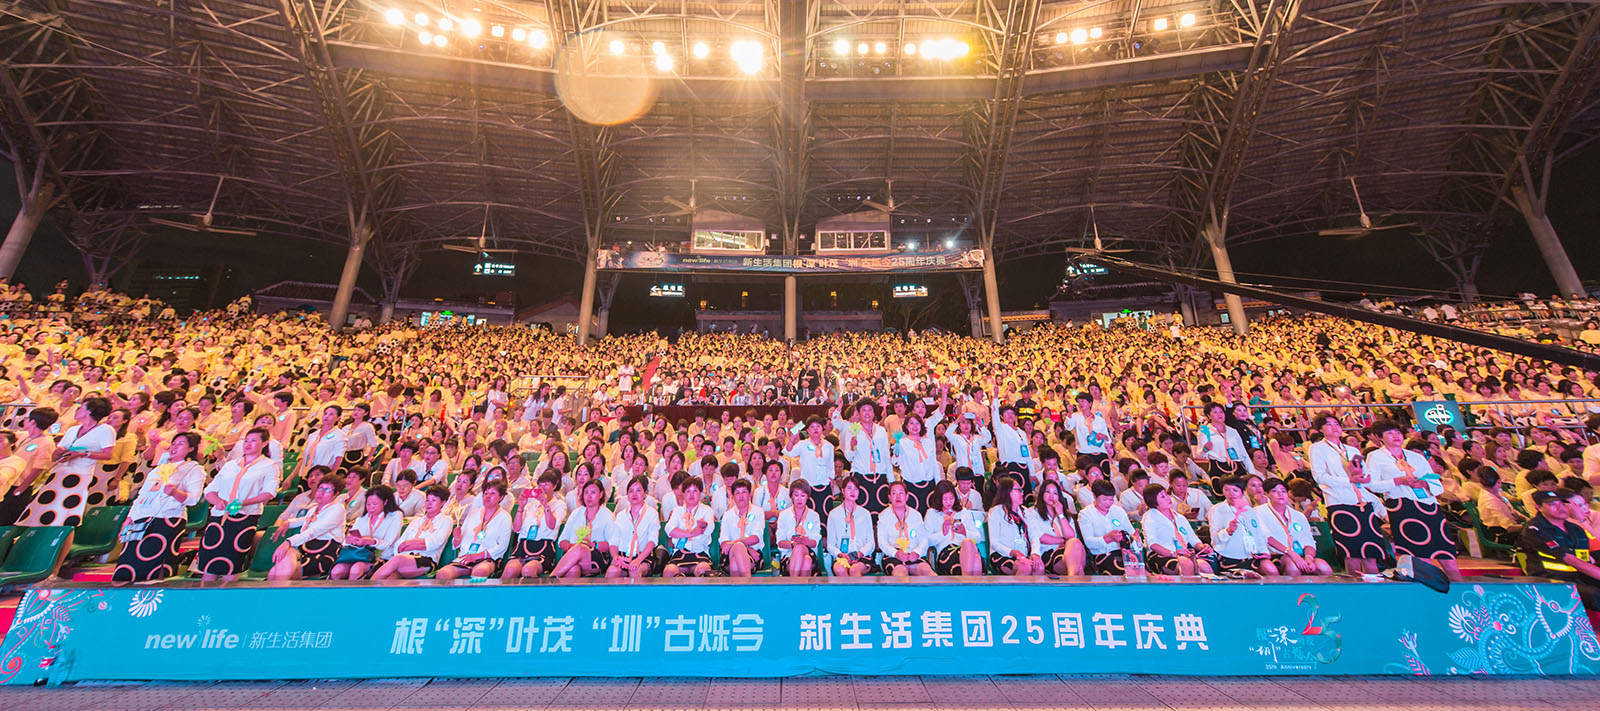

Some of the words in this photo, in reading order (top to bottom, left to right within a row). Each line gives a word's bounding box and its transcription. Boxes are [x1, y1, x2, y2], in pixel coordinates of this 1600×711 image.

[144, 634, 197, 649] new
[201, 629, 239, 649] life
[249, 631, 333, 649] 新生活集团
[799, 611, 1209, 651] 新生活集团25周年庆典
